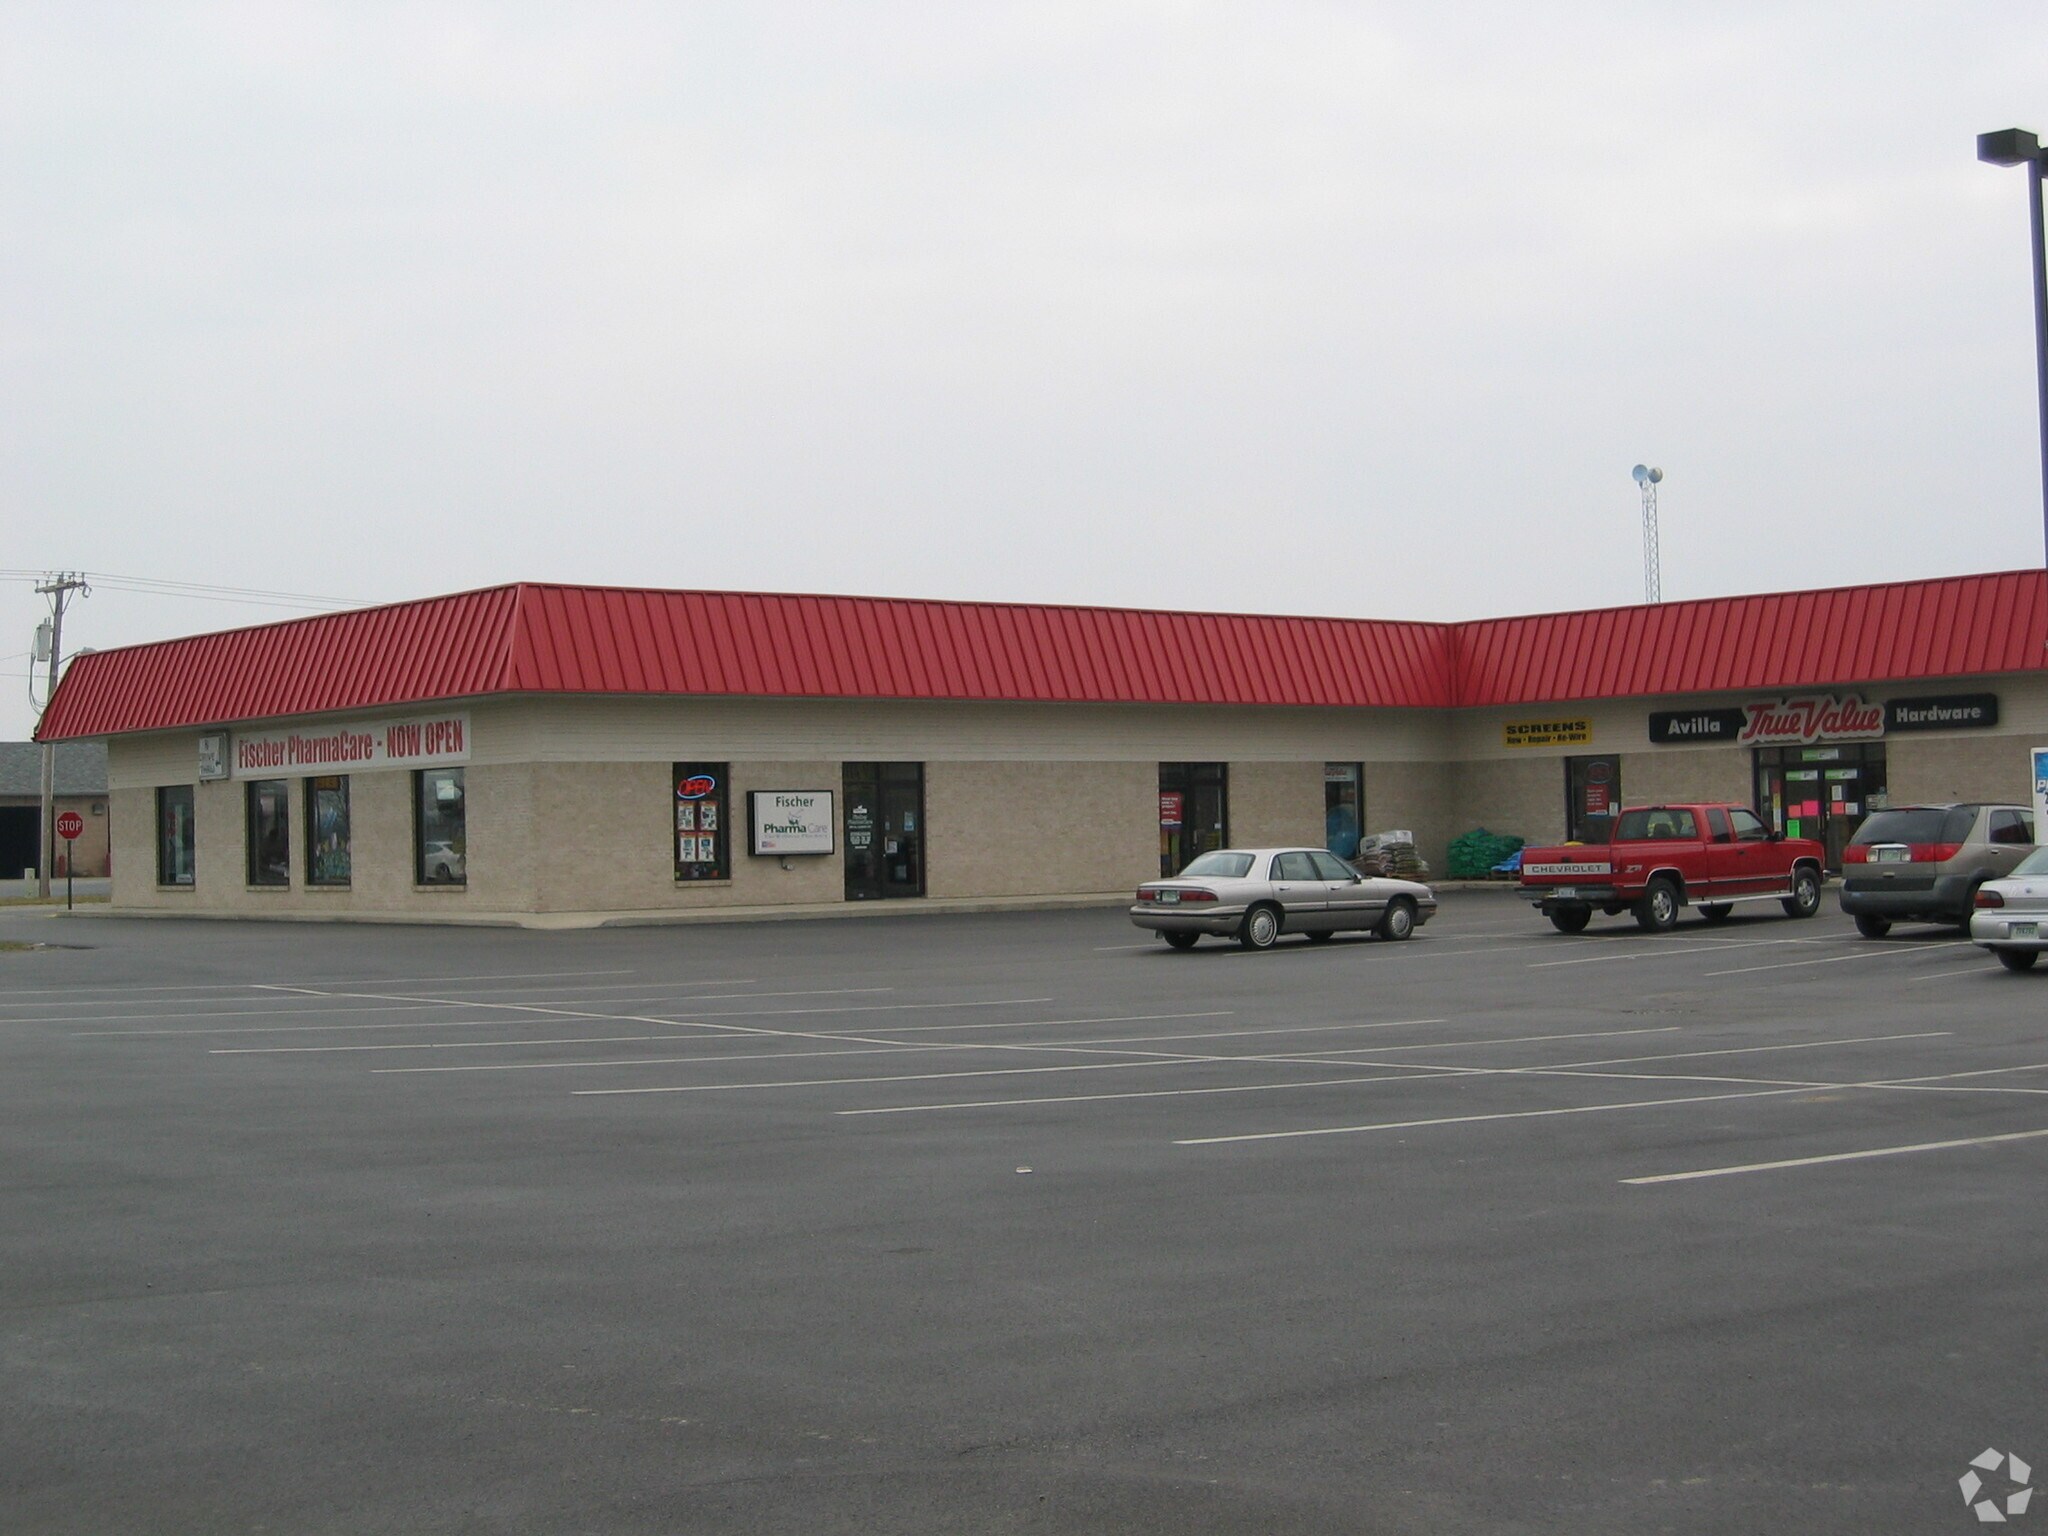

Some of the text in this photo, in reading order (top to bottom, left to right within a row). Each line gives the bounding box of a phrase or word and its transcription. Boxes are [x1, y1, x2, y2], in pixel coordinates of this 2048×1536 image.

[1896, 705, 1982, 723] Hardware
[1506, 721, 1586, 734] SCREENS
[1668, 717, 1720, 734] Avilla
[239, 739, 284, 768] Fischer
[288, 731, 373, 765] PharmaCare
[387, 726, 421, 757] NOW
[425, 720, 463, 754] OPEN
[775, 796, 814, 807] Fischer
[58, 820, 82, 831] STOP
[1532, 865, 1602, 873] CHEVROLET
